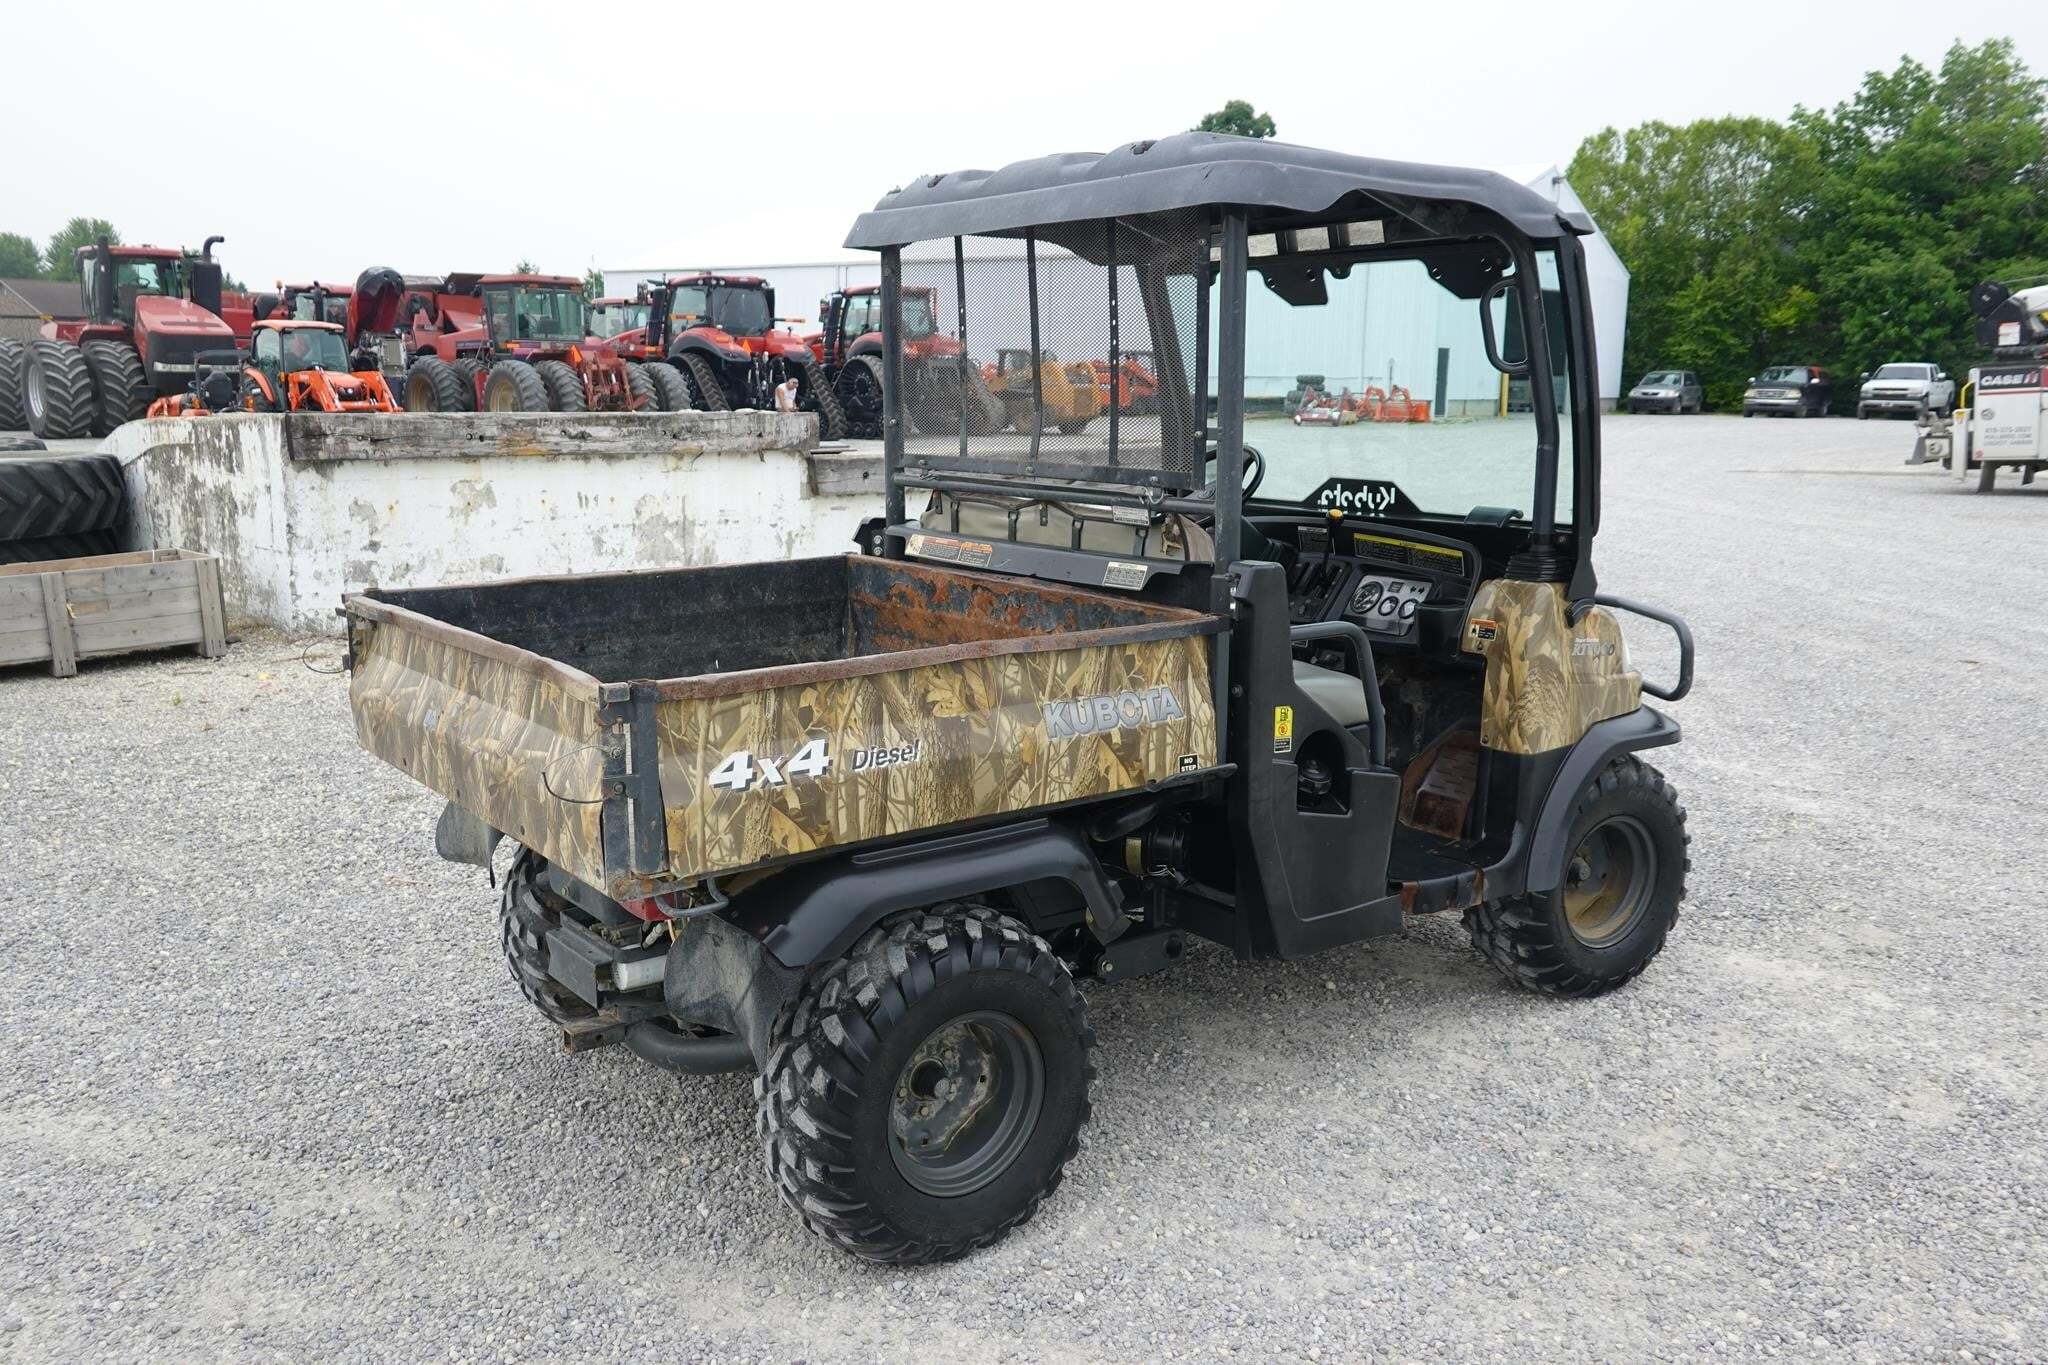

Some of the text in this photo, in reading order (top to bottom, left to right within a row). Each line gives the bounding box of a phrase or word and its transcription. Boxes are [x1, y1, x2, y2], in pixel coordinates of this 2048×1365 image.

[1981, 374, 2024, 386] CASE
[1043, 684, 1186, 740] KUBOTA
[709, 739, 920, 792] 4x4 Diesel
